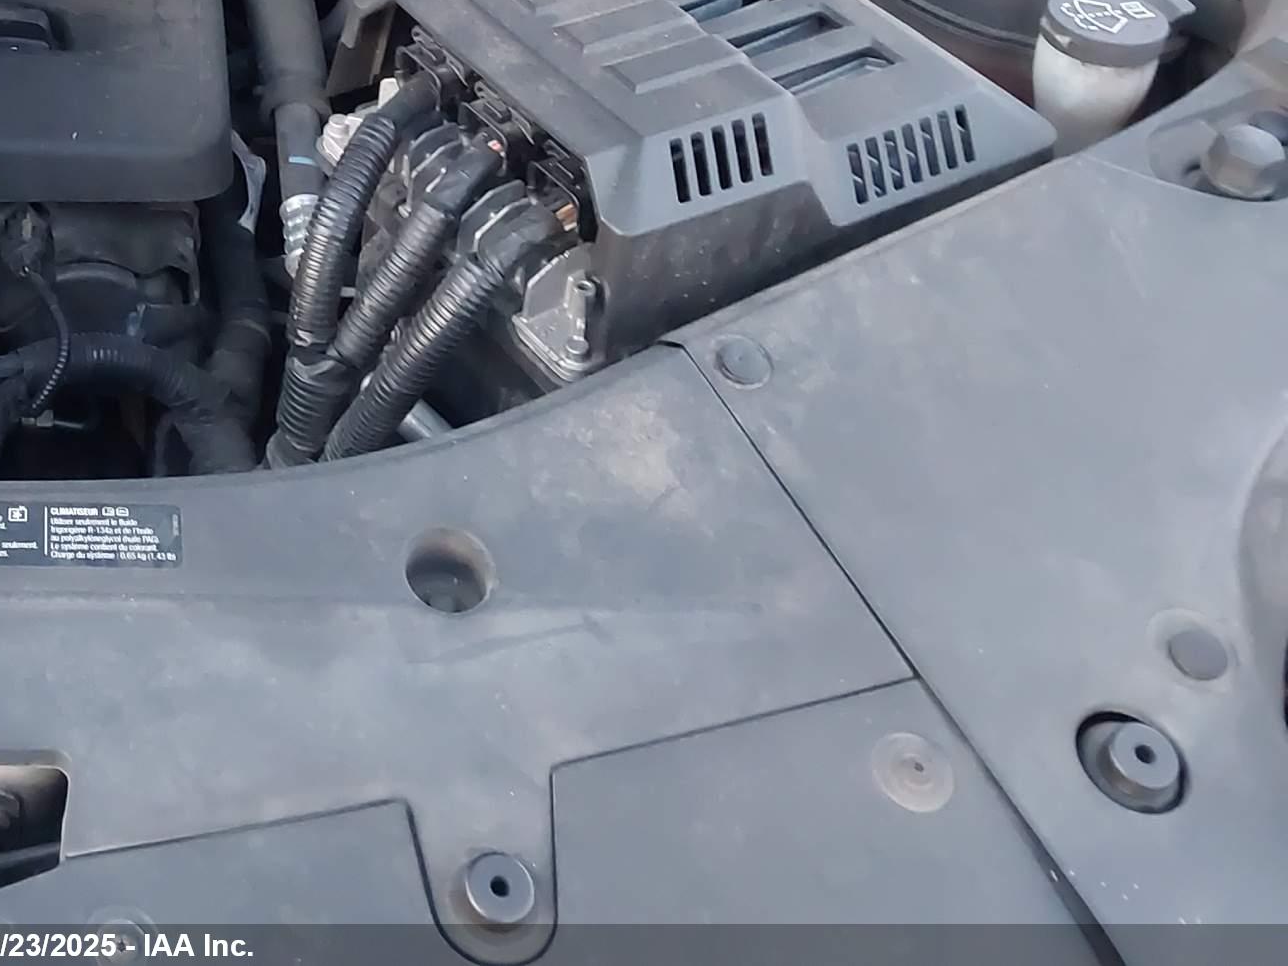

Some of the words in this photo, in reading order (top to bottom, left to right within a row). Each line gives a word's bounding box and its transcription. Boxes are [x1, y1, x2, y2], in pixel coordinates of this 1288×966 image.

[50, 507, 98, 516] CLIMATISEUR
[88, 527, 114, 535] R-134a
[122, 527, 132, 535] de
